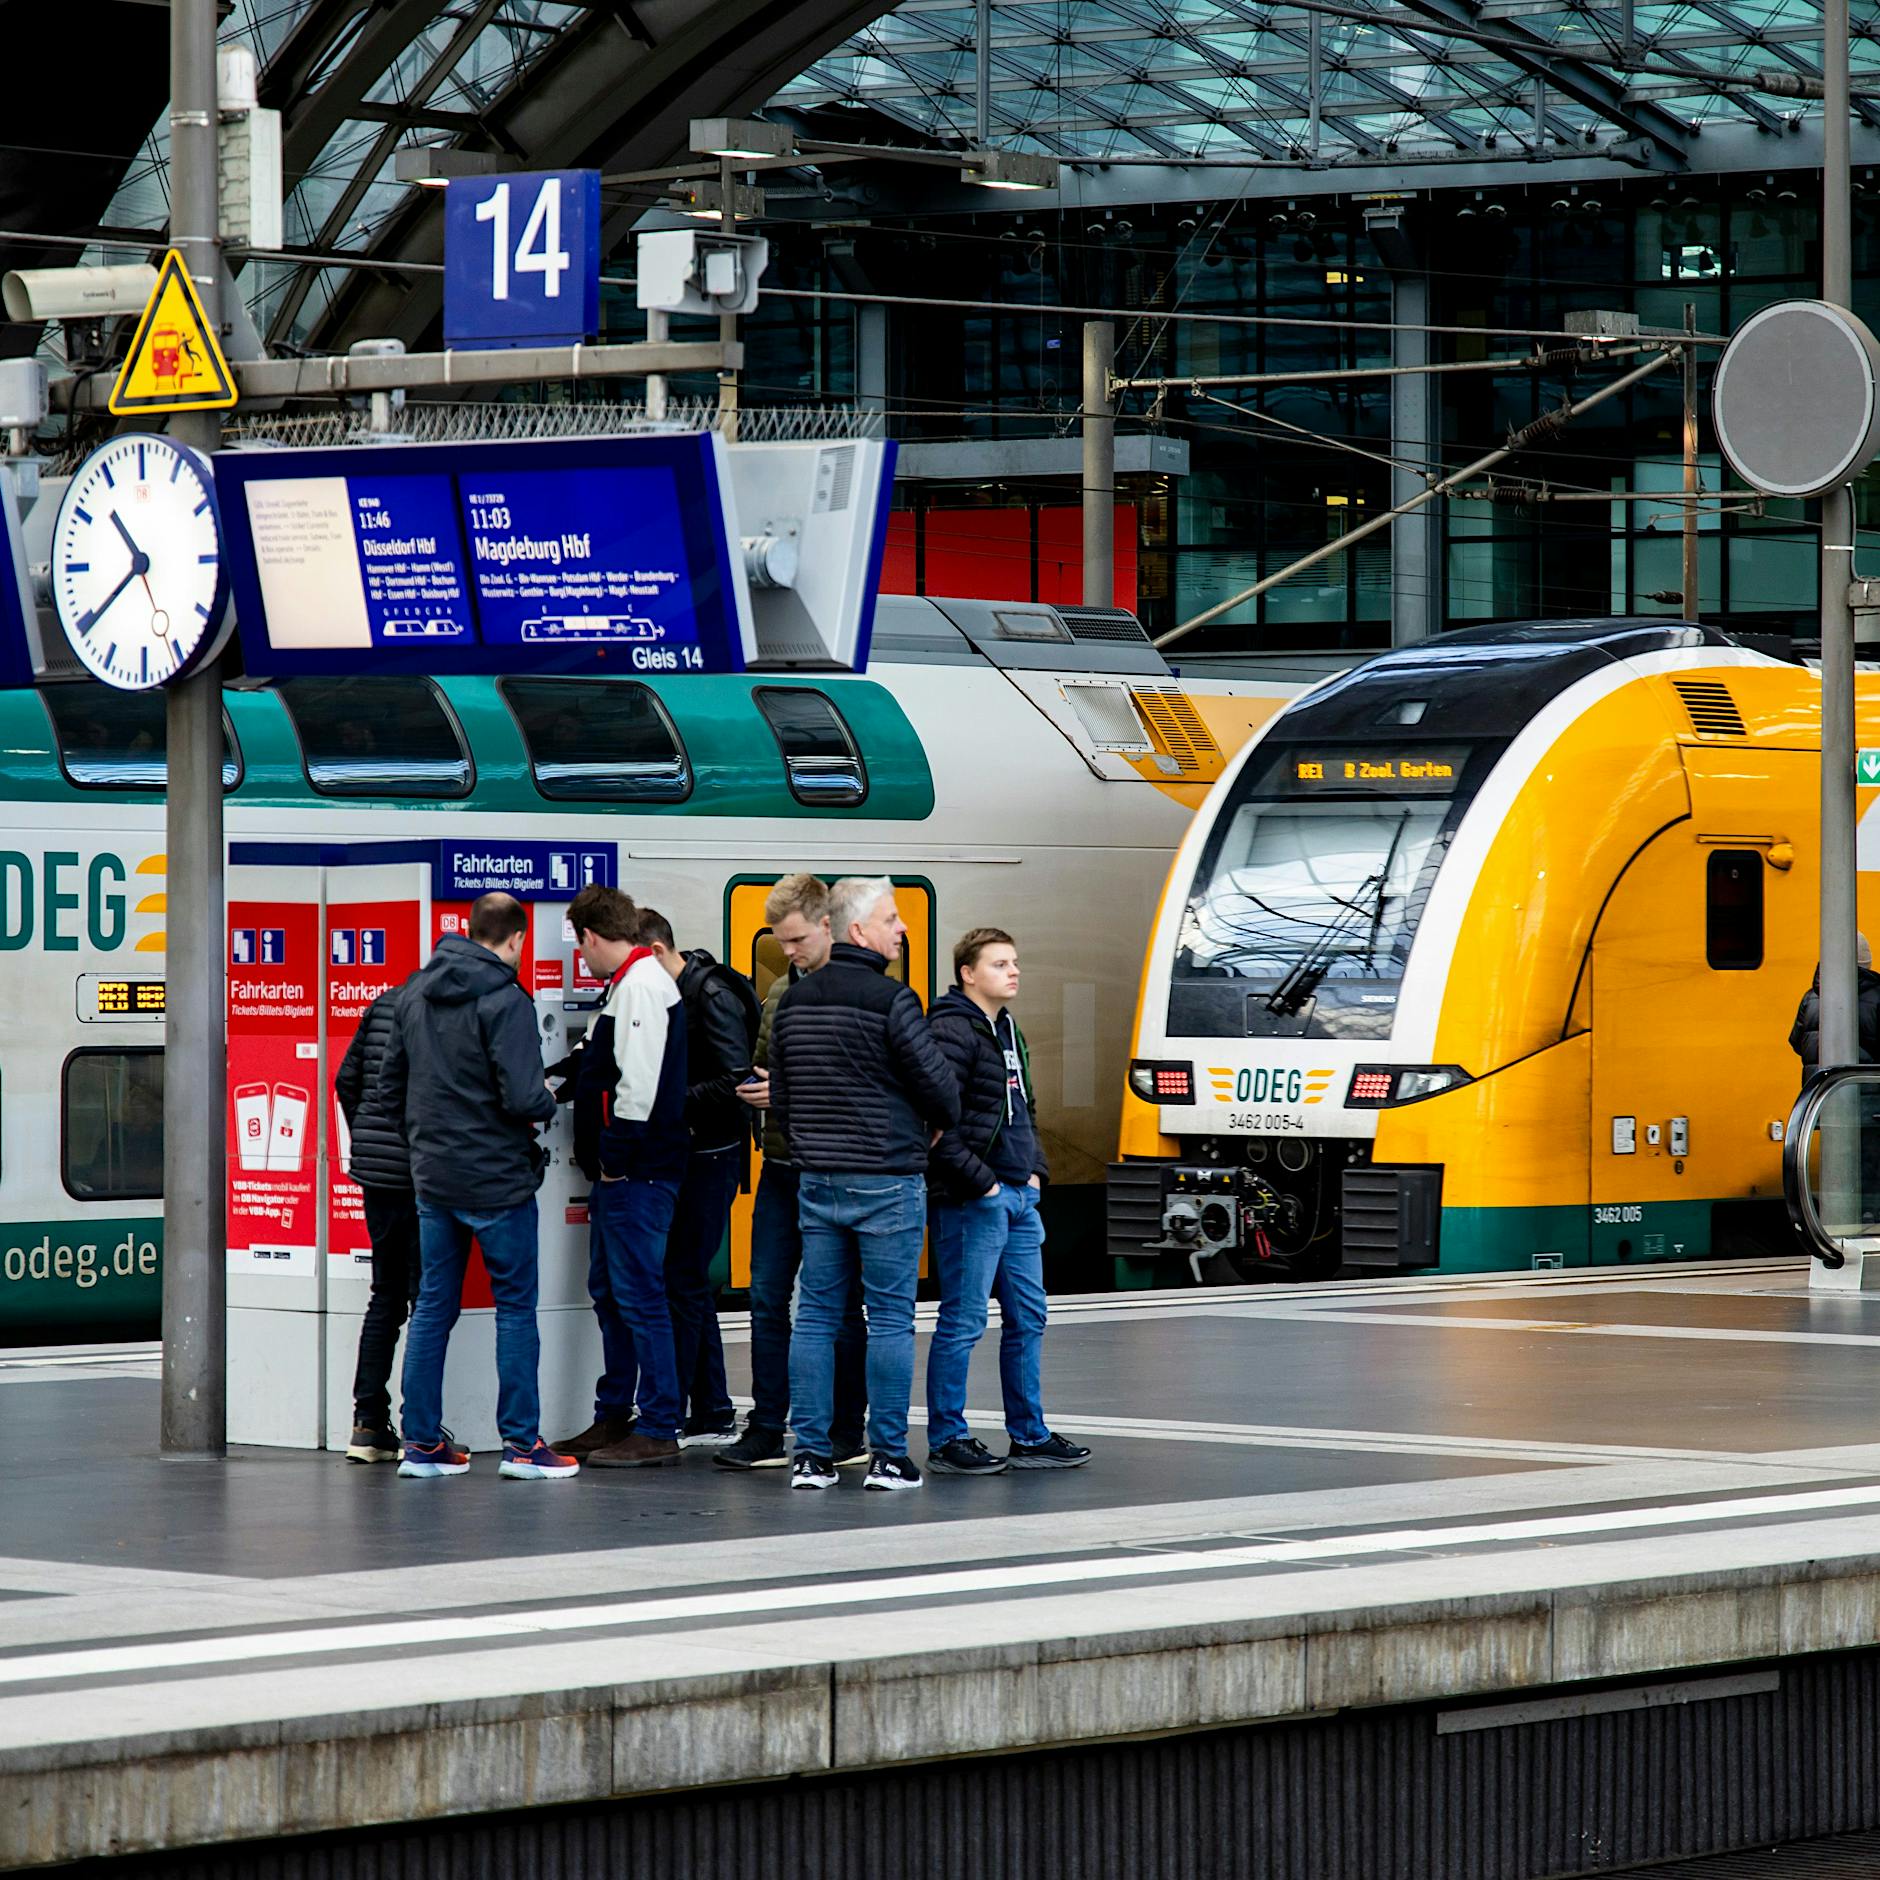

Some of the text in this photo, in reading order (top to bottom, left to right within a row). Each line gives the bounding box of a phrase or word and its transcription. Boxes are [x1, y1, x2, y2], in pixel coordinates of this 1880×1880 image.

[475, 178, 570, 300] 14
[359, 511, 392, 529] 11:46
[471, 507, 511, 529] 11:03
[363, 537, 437, 556] Düsseldorf Hbf
[475, 533, 591, 566] Magdeburg Hbf
[632, 647, 704, 669] Gleis 14
[1297, 763, 1323, 779] RE1
[1400, 761, 1453, 778] Garten
[453, 853, 533, 873] Fahrkarten
[454, 876, 544, 892] Tickets/Billets/Biglietti
[0, 850, 126, 951] DEG
[231, 980, 304, 999] Fahrkarten
[231, 1004, 314, 1018] Tickets/Billets/Biglietti
[1236, 1068, 1302, 1103] ODEG
[1228, 1113, 1304, 1130] 3462 005-4
[333, 1184, 364, 1194] VBB-Tick
[251, 1194, 284, 1205] Navigator
[1594, 1206, 1643, 1224] 3462 005
[4, 1233, 157, 1288] odeg.de
